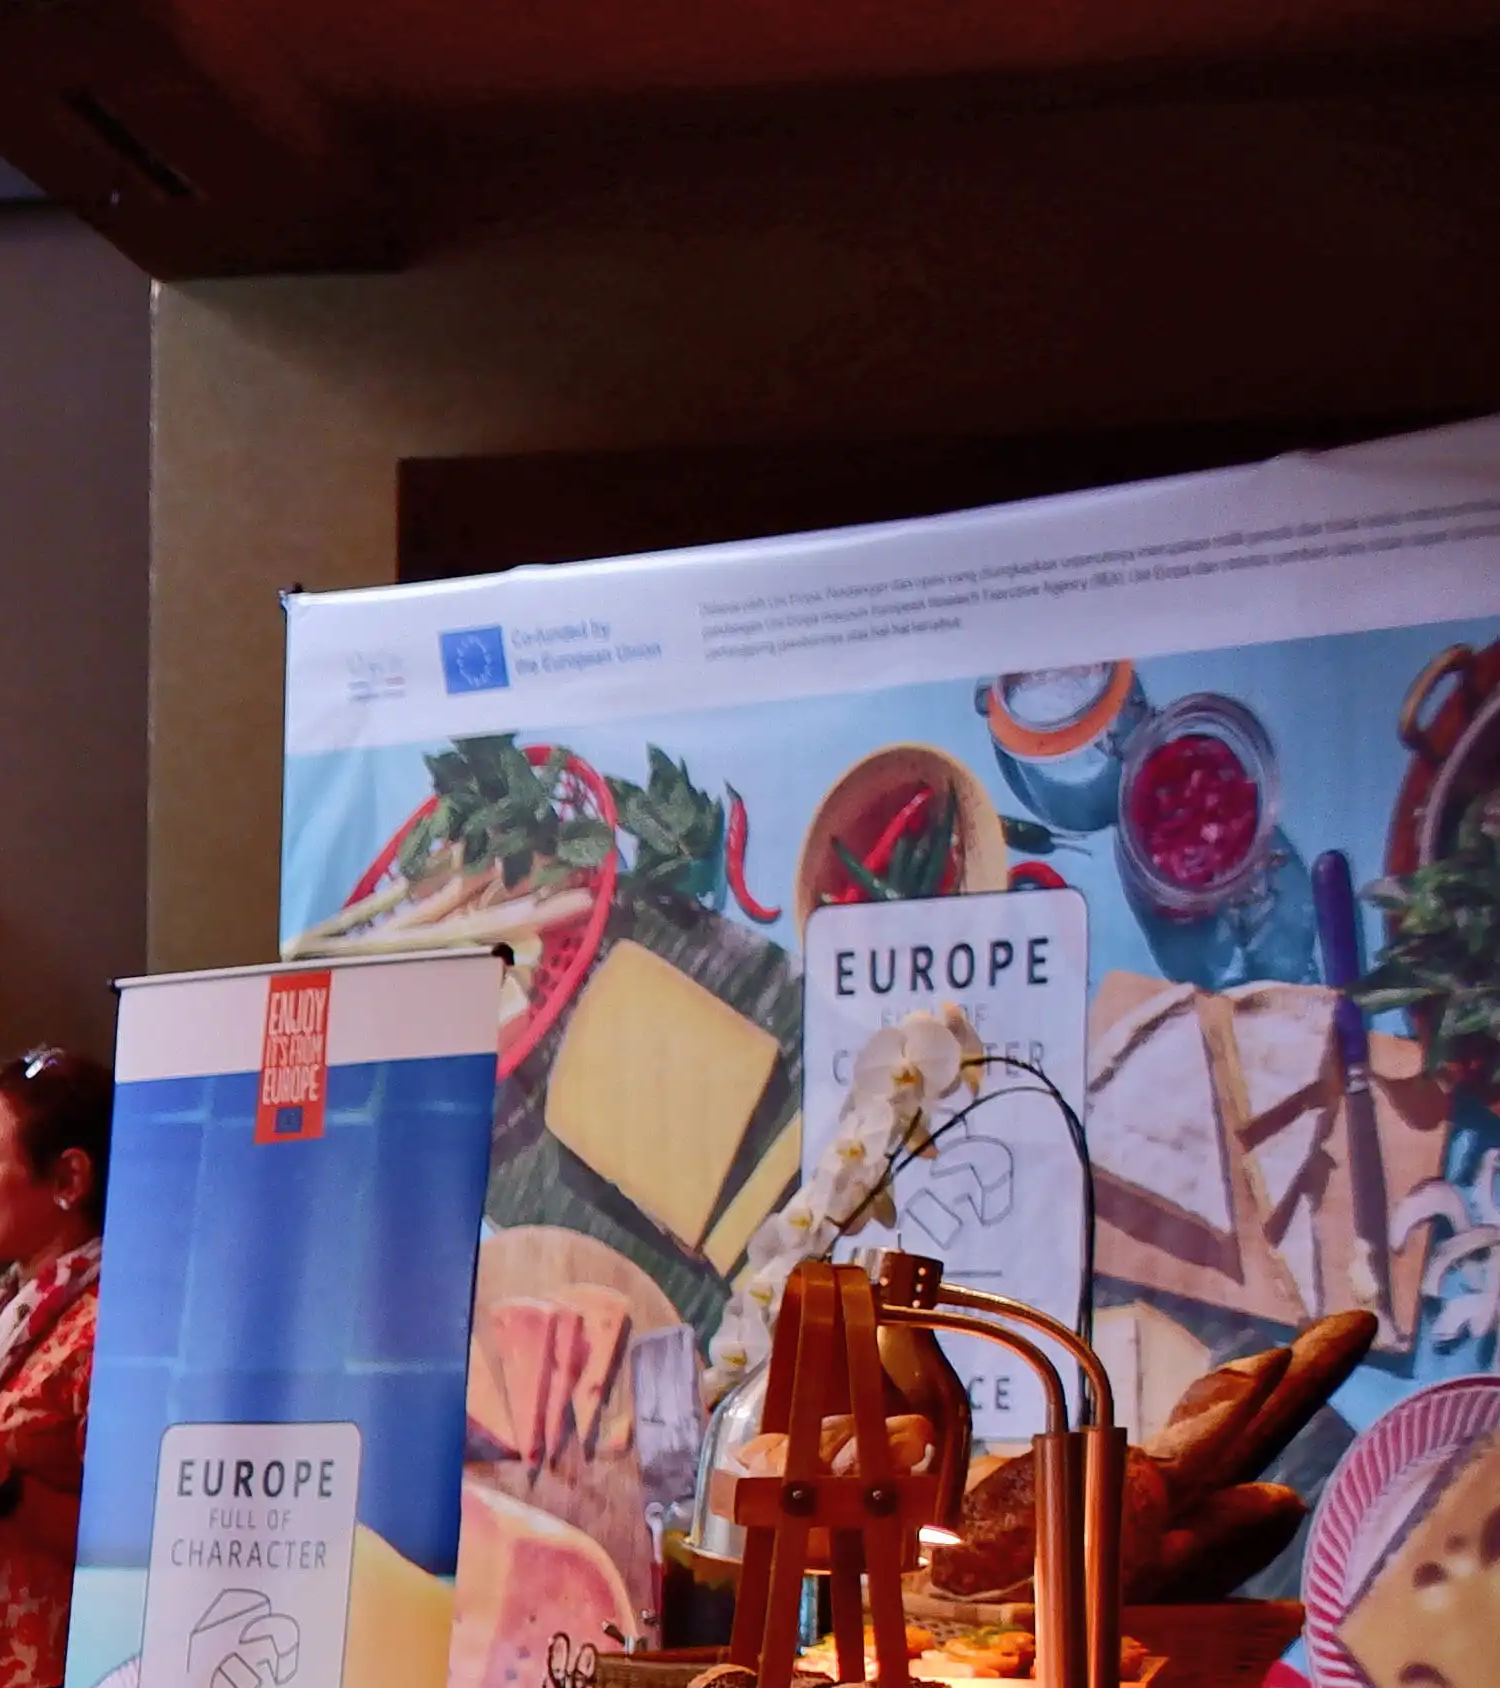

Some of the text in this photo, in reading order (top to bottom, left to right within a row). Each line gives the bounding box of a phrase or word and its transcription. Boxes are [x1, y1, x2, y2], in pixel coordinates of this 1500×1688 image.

[836, 938, 1049, 996] EUROPE
[268, 986, 328, 1036] ENJOY
[290, 1032, 325, 1067] FROM
[262, 1063, 320, 1106] EUROPE
[176, 1458, 335, 1498] EUROPE
[209, 1507, 292, 1530] FULL OF
[170, 1538, 328, 1570] CHARACTER
